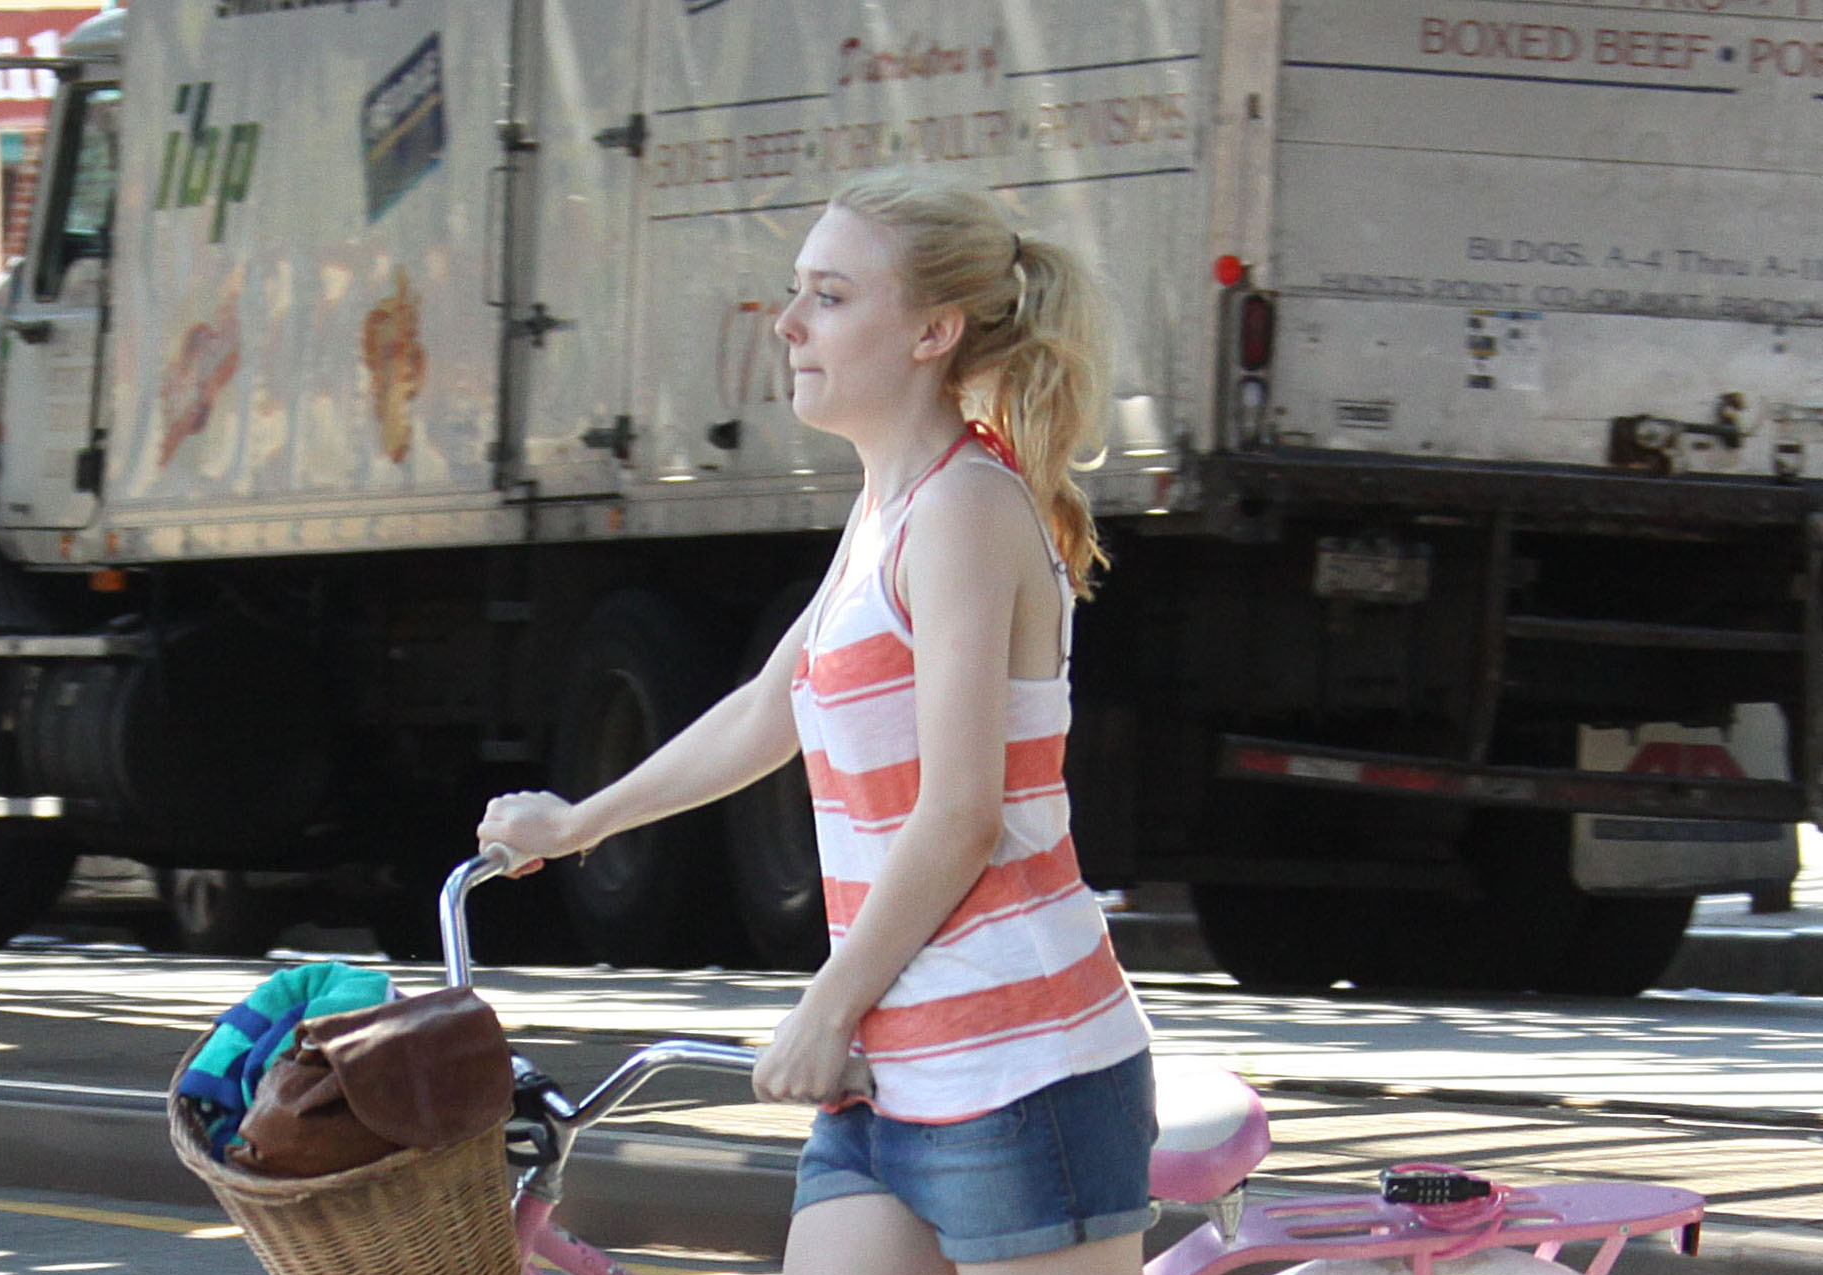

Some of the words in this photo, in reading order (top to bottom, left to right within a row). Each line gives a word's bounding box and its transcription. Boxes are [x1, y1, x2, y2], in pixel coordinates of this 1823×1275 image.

[1420, 18, 1579, 62] BOXED
[1596, 29, 1712, 69] BEEF
[741, 129, 806, 179] BEEF
